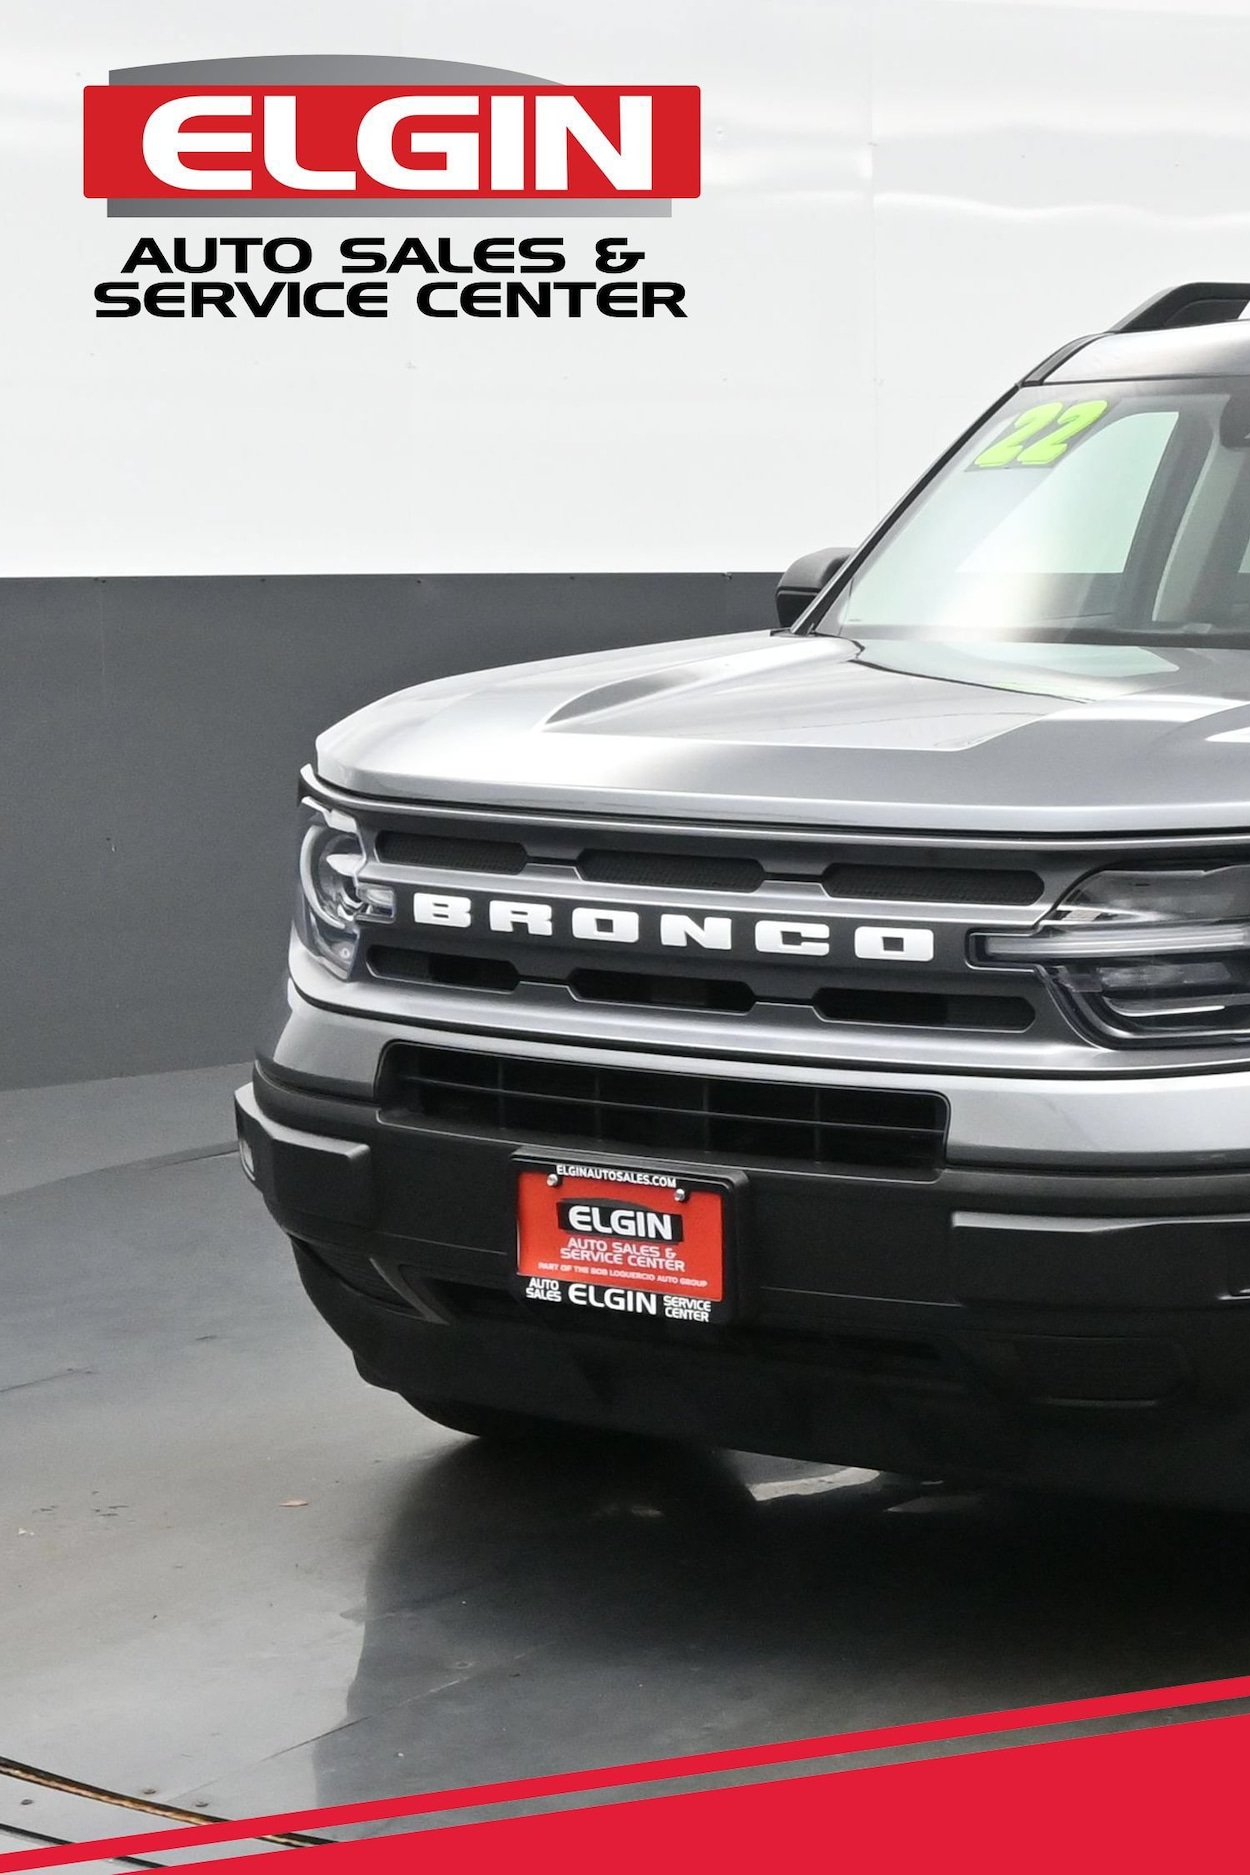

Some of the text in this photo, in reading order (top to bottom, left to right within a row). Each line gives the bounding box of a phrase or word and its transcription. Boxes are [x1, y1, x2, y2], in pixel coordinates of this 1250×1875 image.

[974, 399, 1108, 468] 22
[412, 892, 935, 962] BRONCO
[556, 1165, 677, 1188] ELGINAUTOSALES.COM
[568, 1205, 673, 1240] ELGIN
[567, 1237, 677, 1259] AUTO SALES &
[560, 1248, 685, 1272] SERVICE CENTER
[529, 1277, 559, 1291] AUTO
[538, 1262, 559, 1271] PART
[574, 1266, 590, 1274] THE
[591, 1267, 608, 1275] BOB
[609, 1269, 655, 1281] LOQUERCIO
[657, 1275, 679, 1284] AUTO
[680, 1277, 708, 1287] GROUP
[525, 1288, 562, 1302] SALES
[568, 1283, 657, 1315] ELGIN
[663, 1295, 712, 1312] SERVICE
[665, 1307, 709, 1323] CENTER
